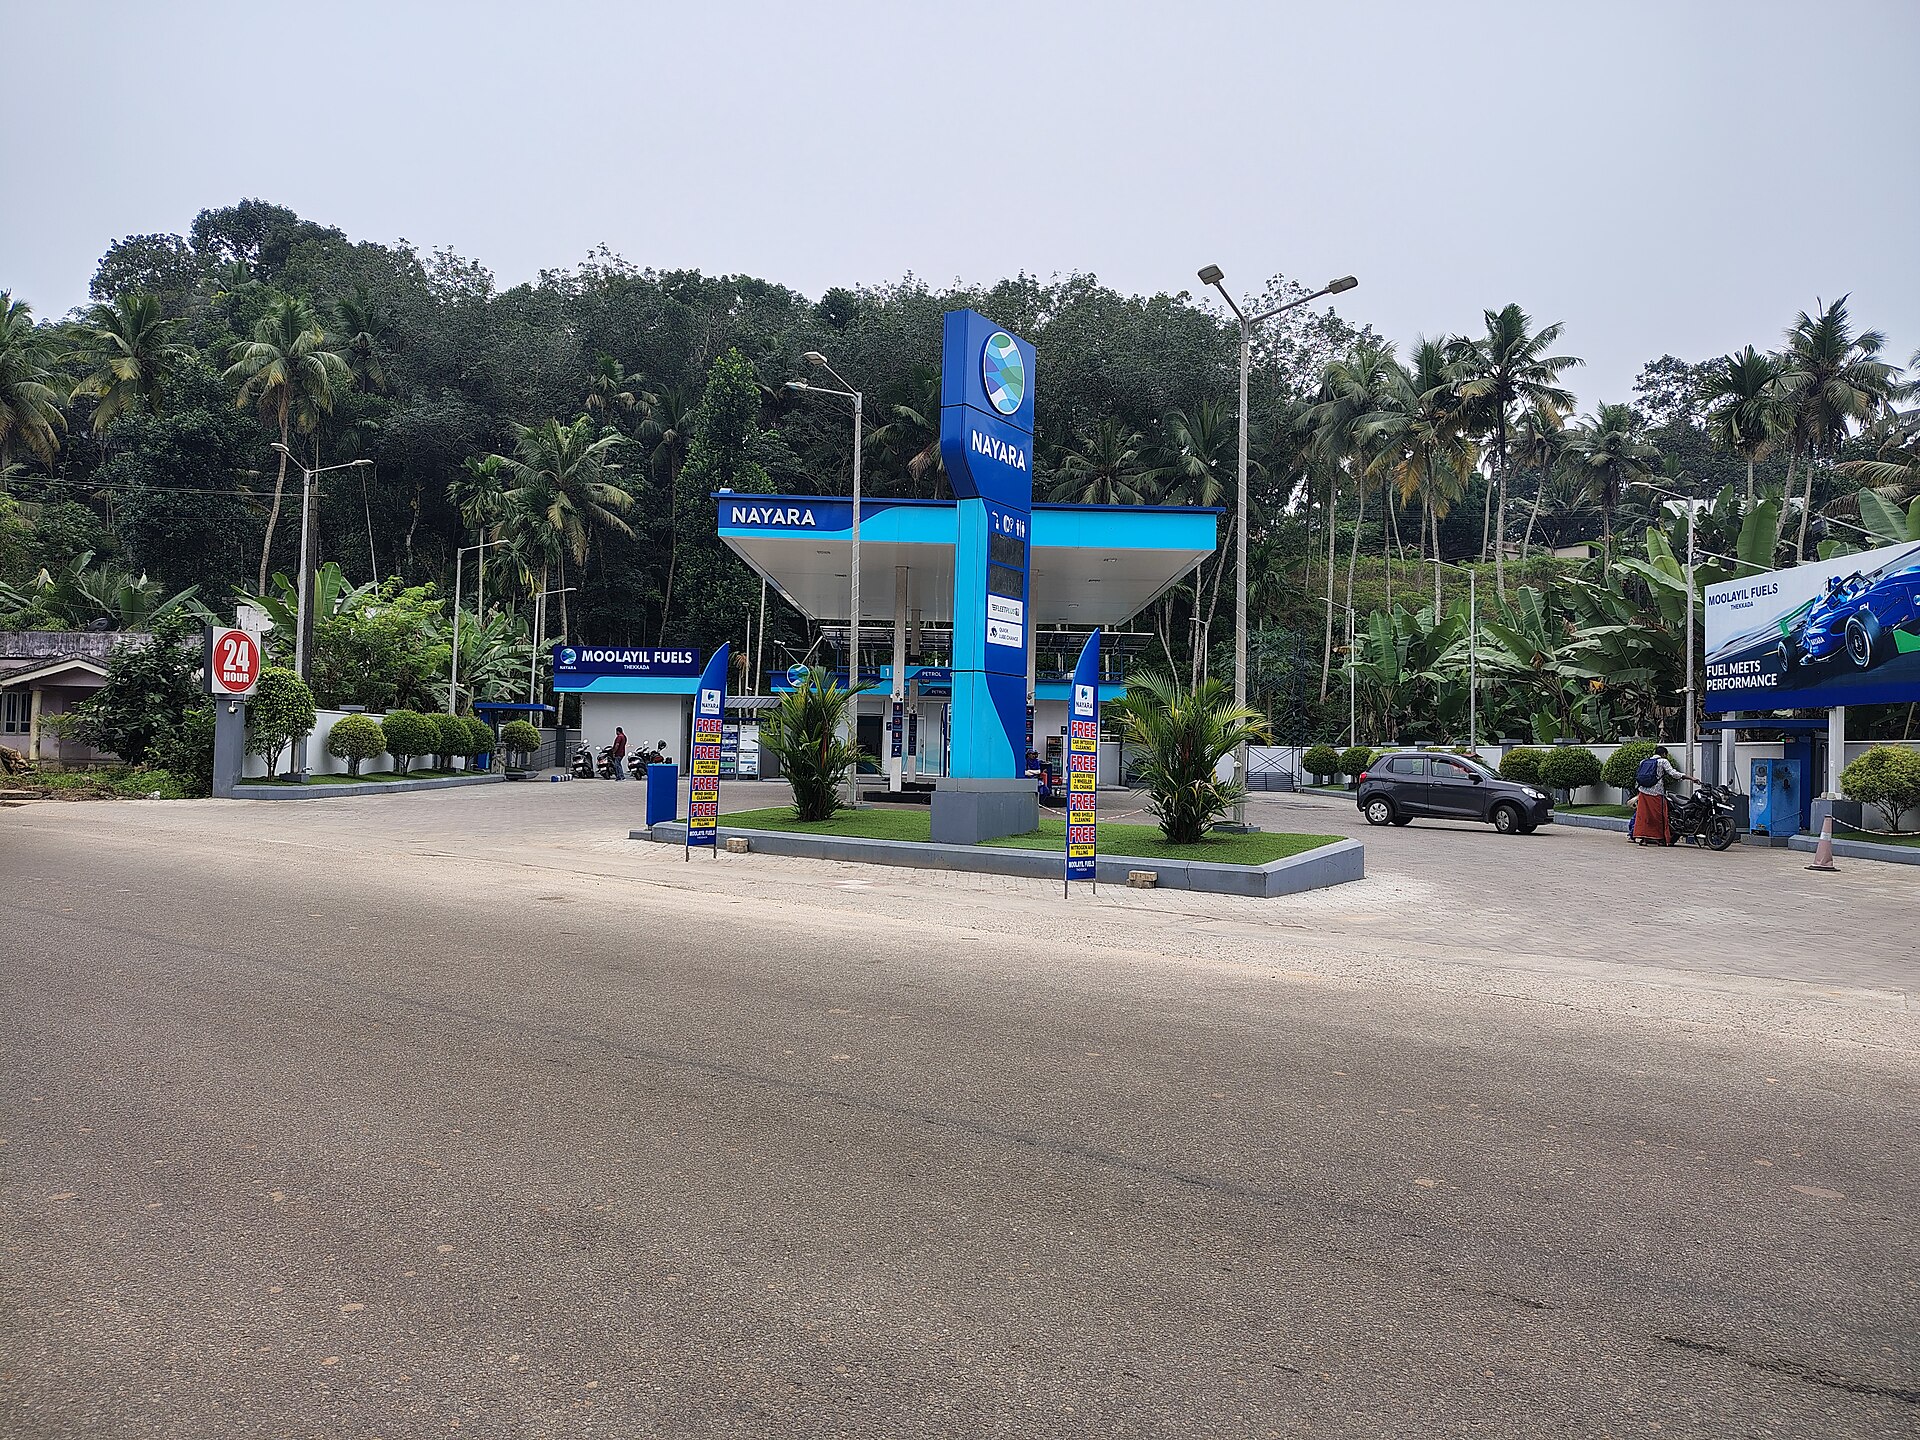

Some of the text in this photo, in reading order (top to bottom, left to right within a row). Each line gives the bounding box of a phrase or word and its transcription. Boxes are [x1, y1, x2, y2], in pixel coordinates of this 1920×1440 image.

[972, 430, 1026, 472] NAYARA
[732, 507, 816, 526] NAYARA
[1708, 583, 1778, 606] MOOLAYIL FUELS
[1730, 601, 1754, 610] THEKKADA
[224, 639, 250, 672] 24
[581, 650, 693, 664] MOOLAYIL FUELS
[223, 671, 250, 683] HOUR
[1706, 660, 1761, 677] FUEL MEETS
[1706, 673, 1778, 691] PERFORMANCE
[1075, 701, 1093, 709] NAYARA
[696, 718, 722, 732] FREE
[1071, 720, 1096, 739] FREE
[694, 745, 720, 759] FREE
[1070, 754, 1096, 772] FREE
[692, 777, 718, 790] FREE
[691, 803, 717, 816] FREE
[1069, 793, 1096, 810] FREE
[1069, 826, 1095, 843] FREE
